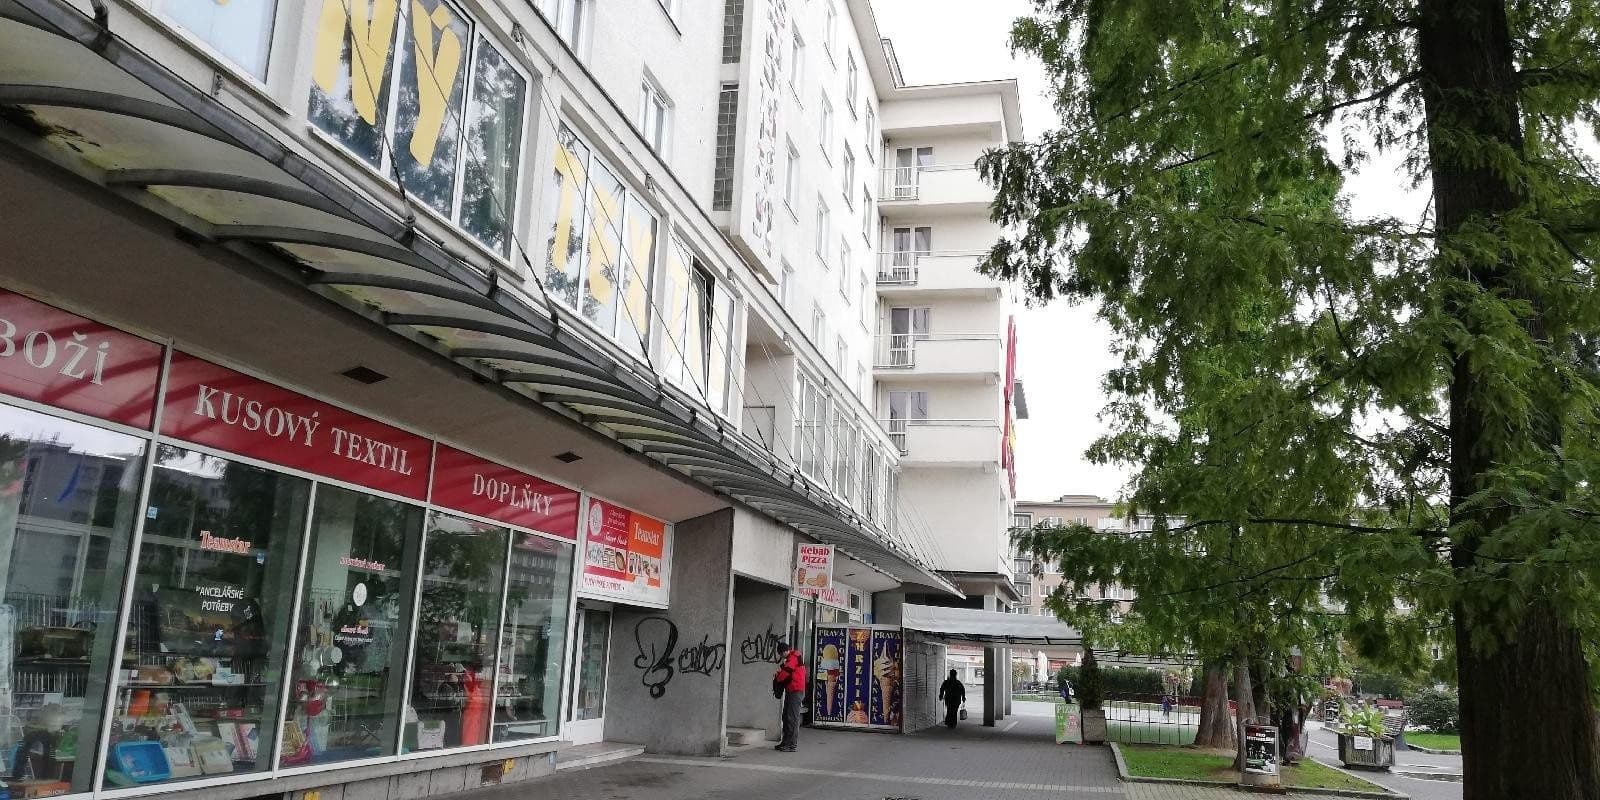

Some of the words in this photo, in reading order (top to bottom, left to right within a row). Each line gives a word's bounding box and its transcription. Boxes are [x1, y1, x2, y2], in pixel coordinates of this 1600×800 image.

[194, 385, 320, 447] KUSOVÝ
[331, 427, 413, 476] TEXTIL
[472, 473, 553, 516] DOPLŇKY
[634, 521, 660, 545] Teamstar
[200, 530, 250, 555] Teamstar
[801, 546, 830, 556] Kebab
[802, 555, 827, 564] Pizza
[202, 600, 234, 613] POTŘEBY
[874, 631, 902, 640] PRAVÁ
